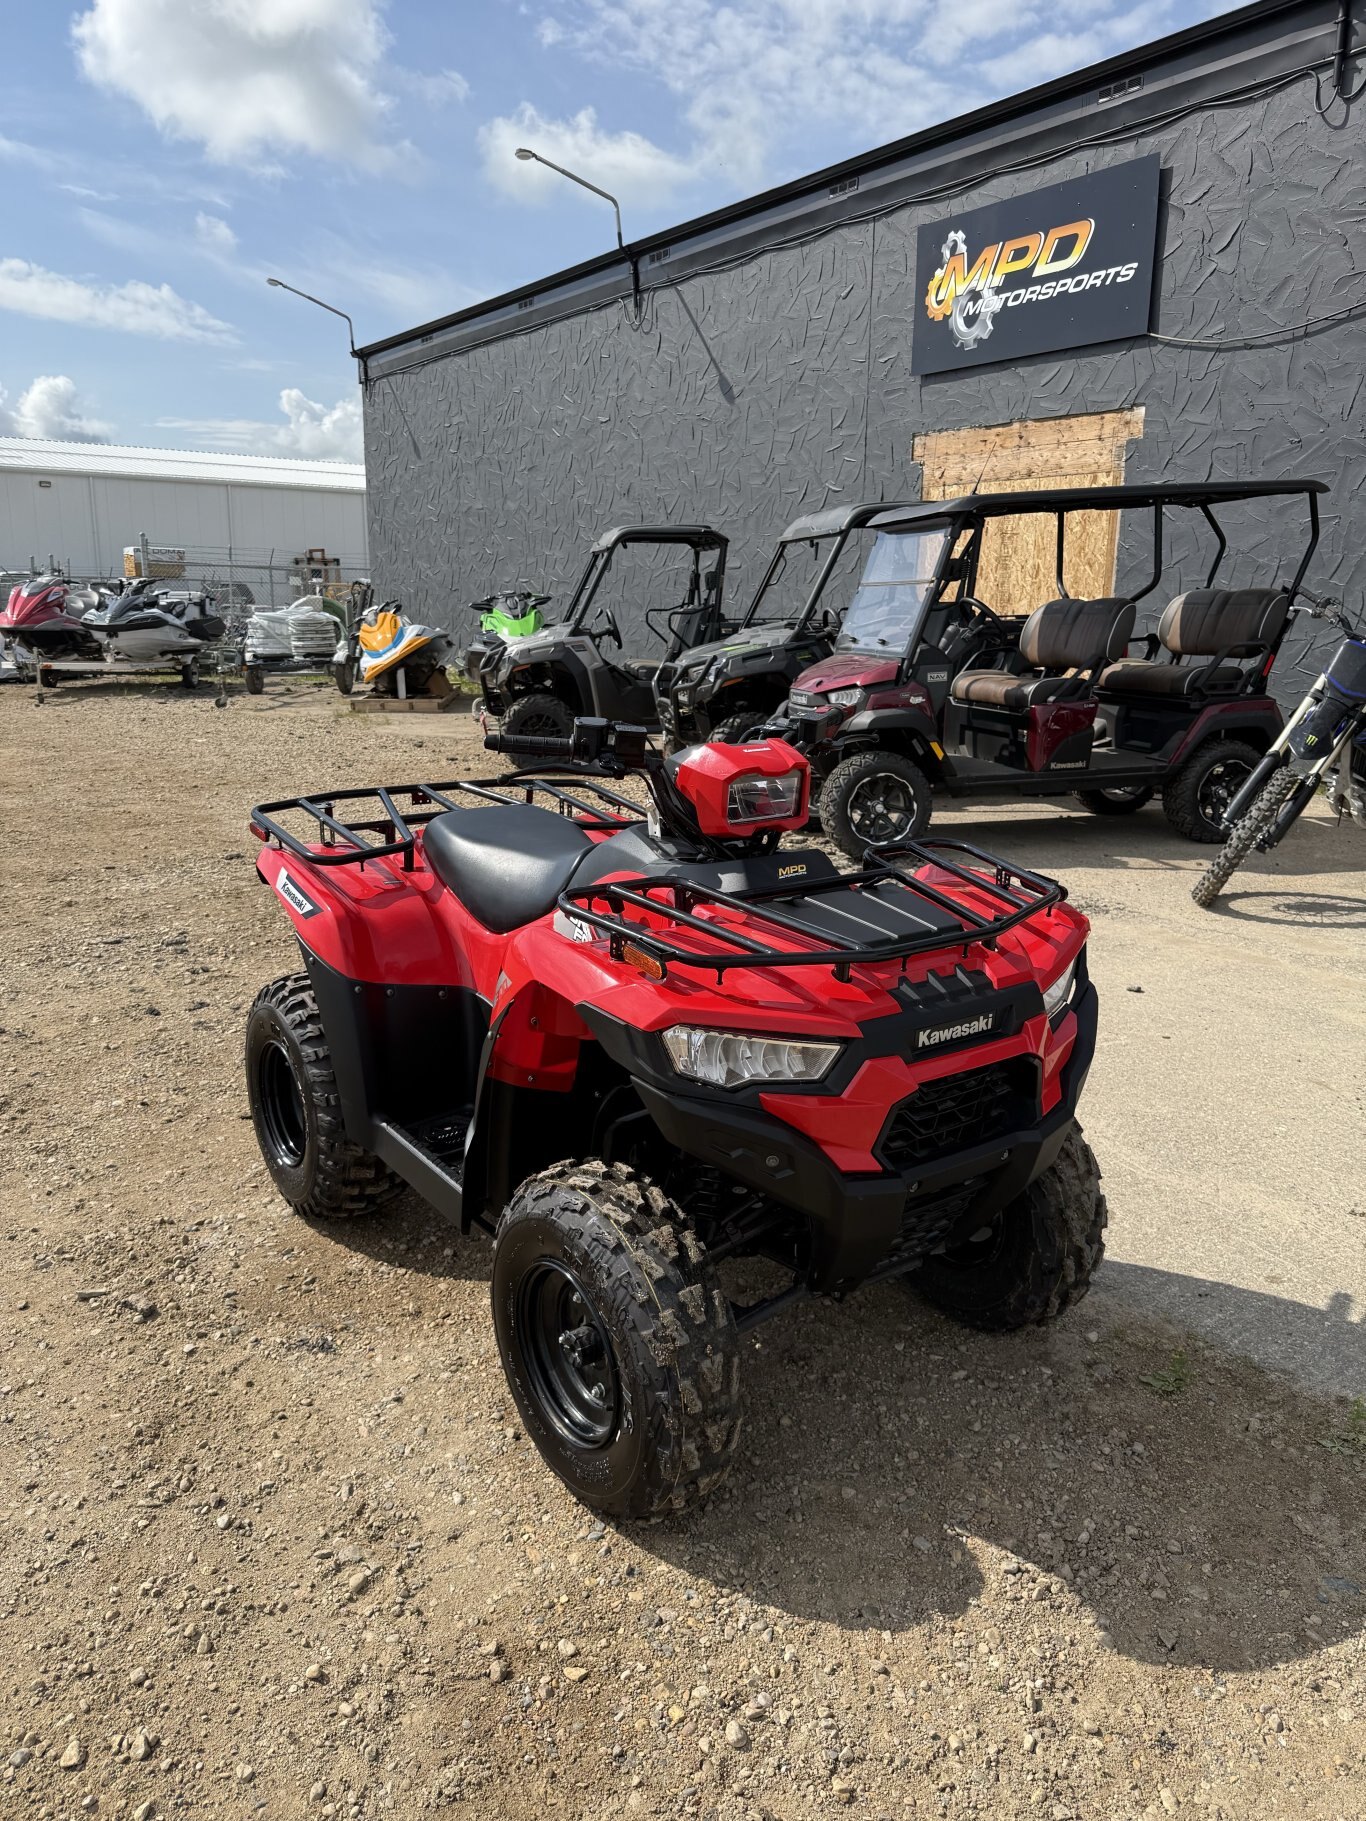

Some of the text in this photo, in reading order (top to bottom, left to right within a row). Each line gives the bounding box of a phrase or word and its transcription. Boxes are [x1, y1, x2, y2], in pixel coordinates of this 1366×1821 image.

[937, 217, 1095, 300] MPD
[963, 262, 1139, 316] MOTORSPORTS
[1050, 761, 1087, 770] Kawasaki
[778, 864, 807, 876] MPD
[281, 881, 307, 911] Kawasaki
[918, 1013, 993, 1048] Kawasaki
